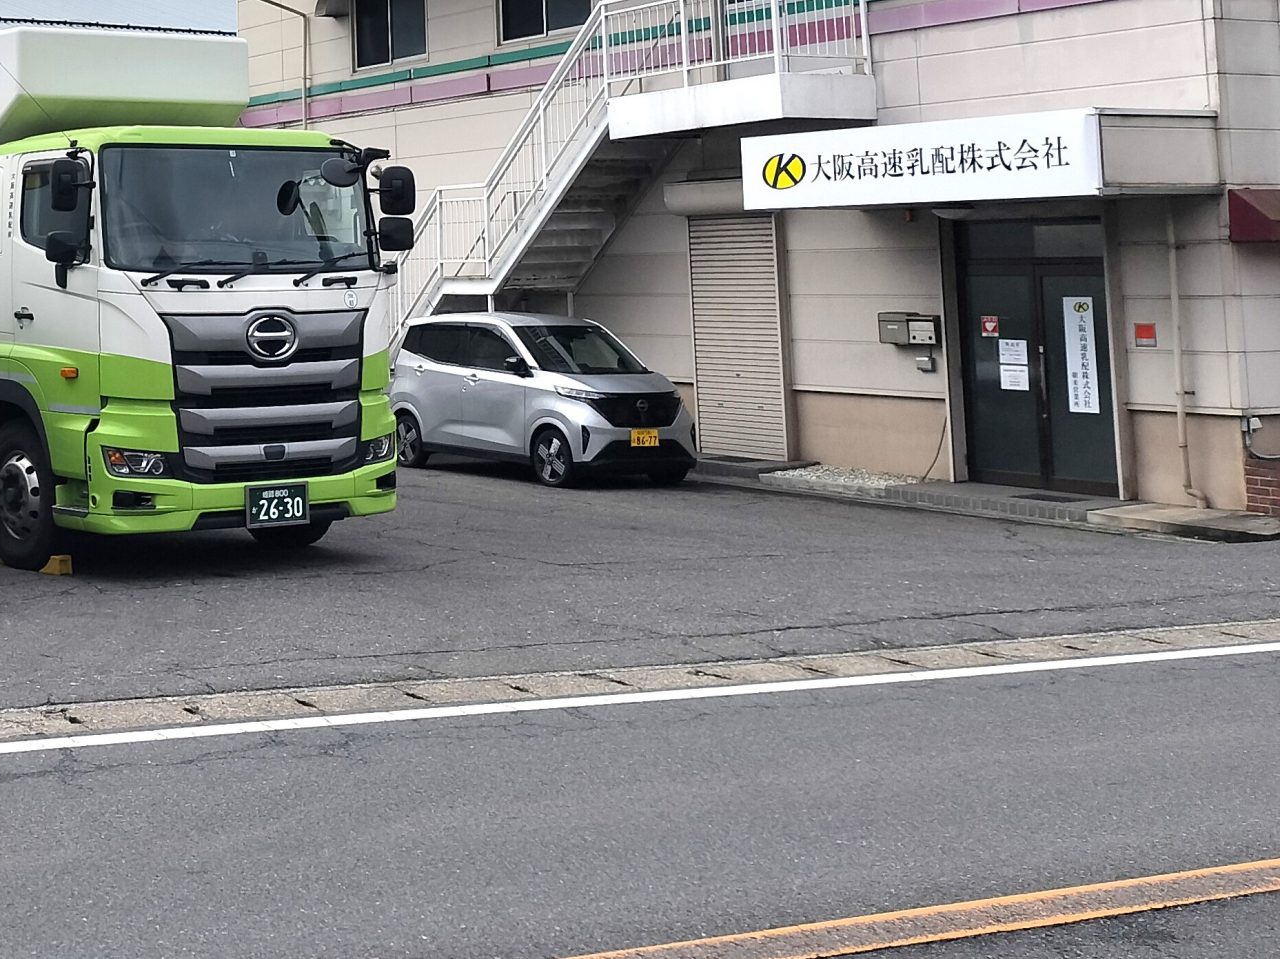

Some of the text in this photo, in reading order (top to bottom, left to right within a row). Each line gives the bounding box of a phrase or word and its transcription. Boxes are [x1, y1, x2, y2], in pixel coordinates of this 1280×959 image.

[811, 136, 1070, 184] 大阪高速乳配株式会社
[636, 435, 657, 446] 86-77
[259, 497, 303, 520] 26-30
